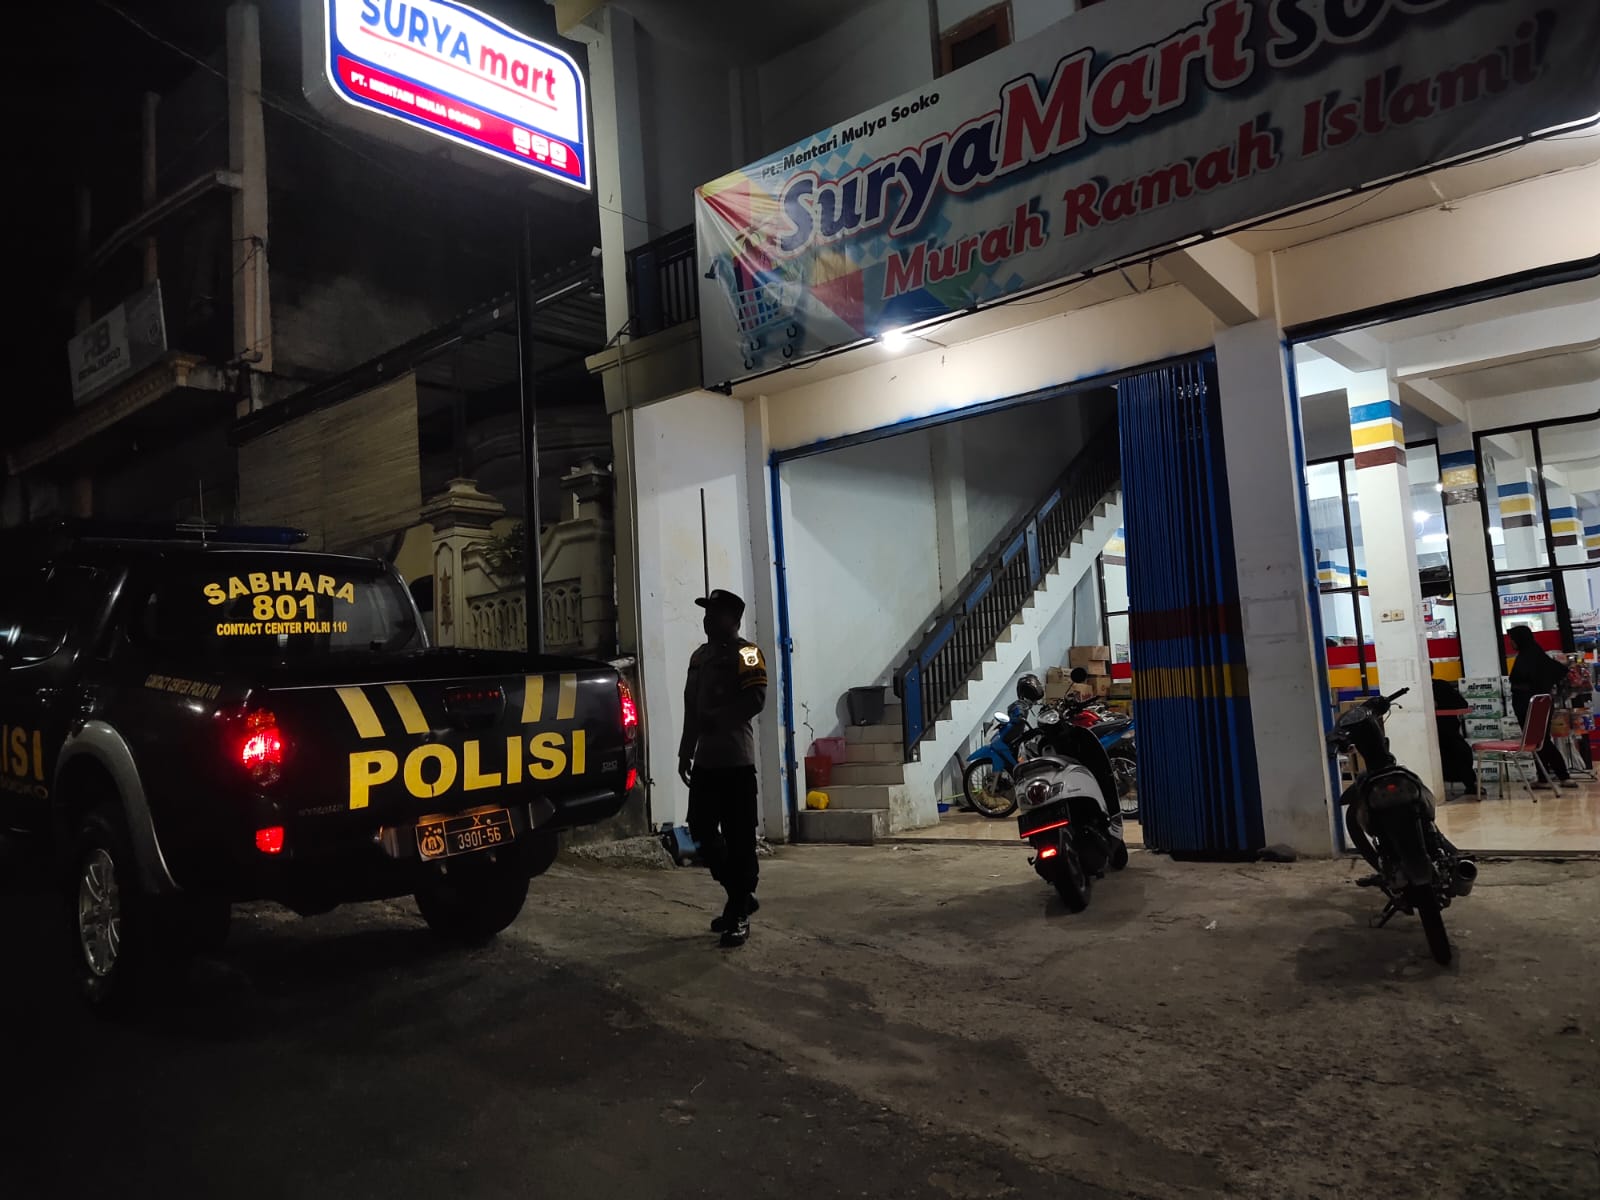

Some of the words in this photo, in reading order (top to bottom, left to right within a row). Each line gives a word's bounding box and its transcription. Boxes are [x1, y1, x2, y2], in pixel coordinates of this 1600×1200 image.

[783, 135, 838, 171] Mentari
[841, 116, 887, 145] Mulya
[890, 92, 940, 123] Sooko
[883, 203, 1044, 297] Murah
[1063, 120, 1276, 237] Ramah
[1301, 19, 1538, 156] Islami
[203, 571, 354, 605] SABHARA
[252, 594, 315, 620] 801
[216, 622, 262, 636] CONTACT
[265, 622, 301, 635] CENTER
[304, 621, 330, 634] POLRI
[332, 621, 347, 633] 110
[349, 729, 586, 810] POLISI
[457, 827, 502, 850] 3901-56
